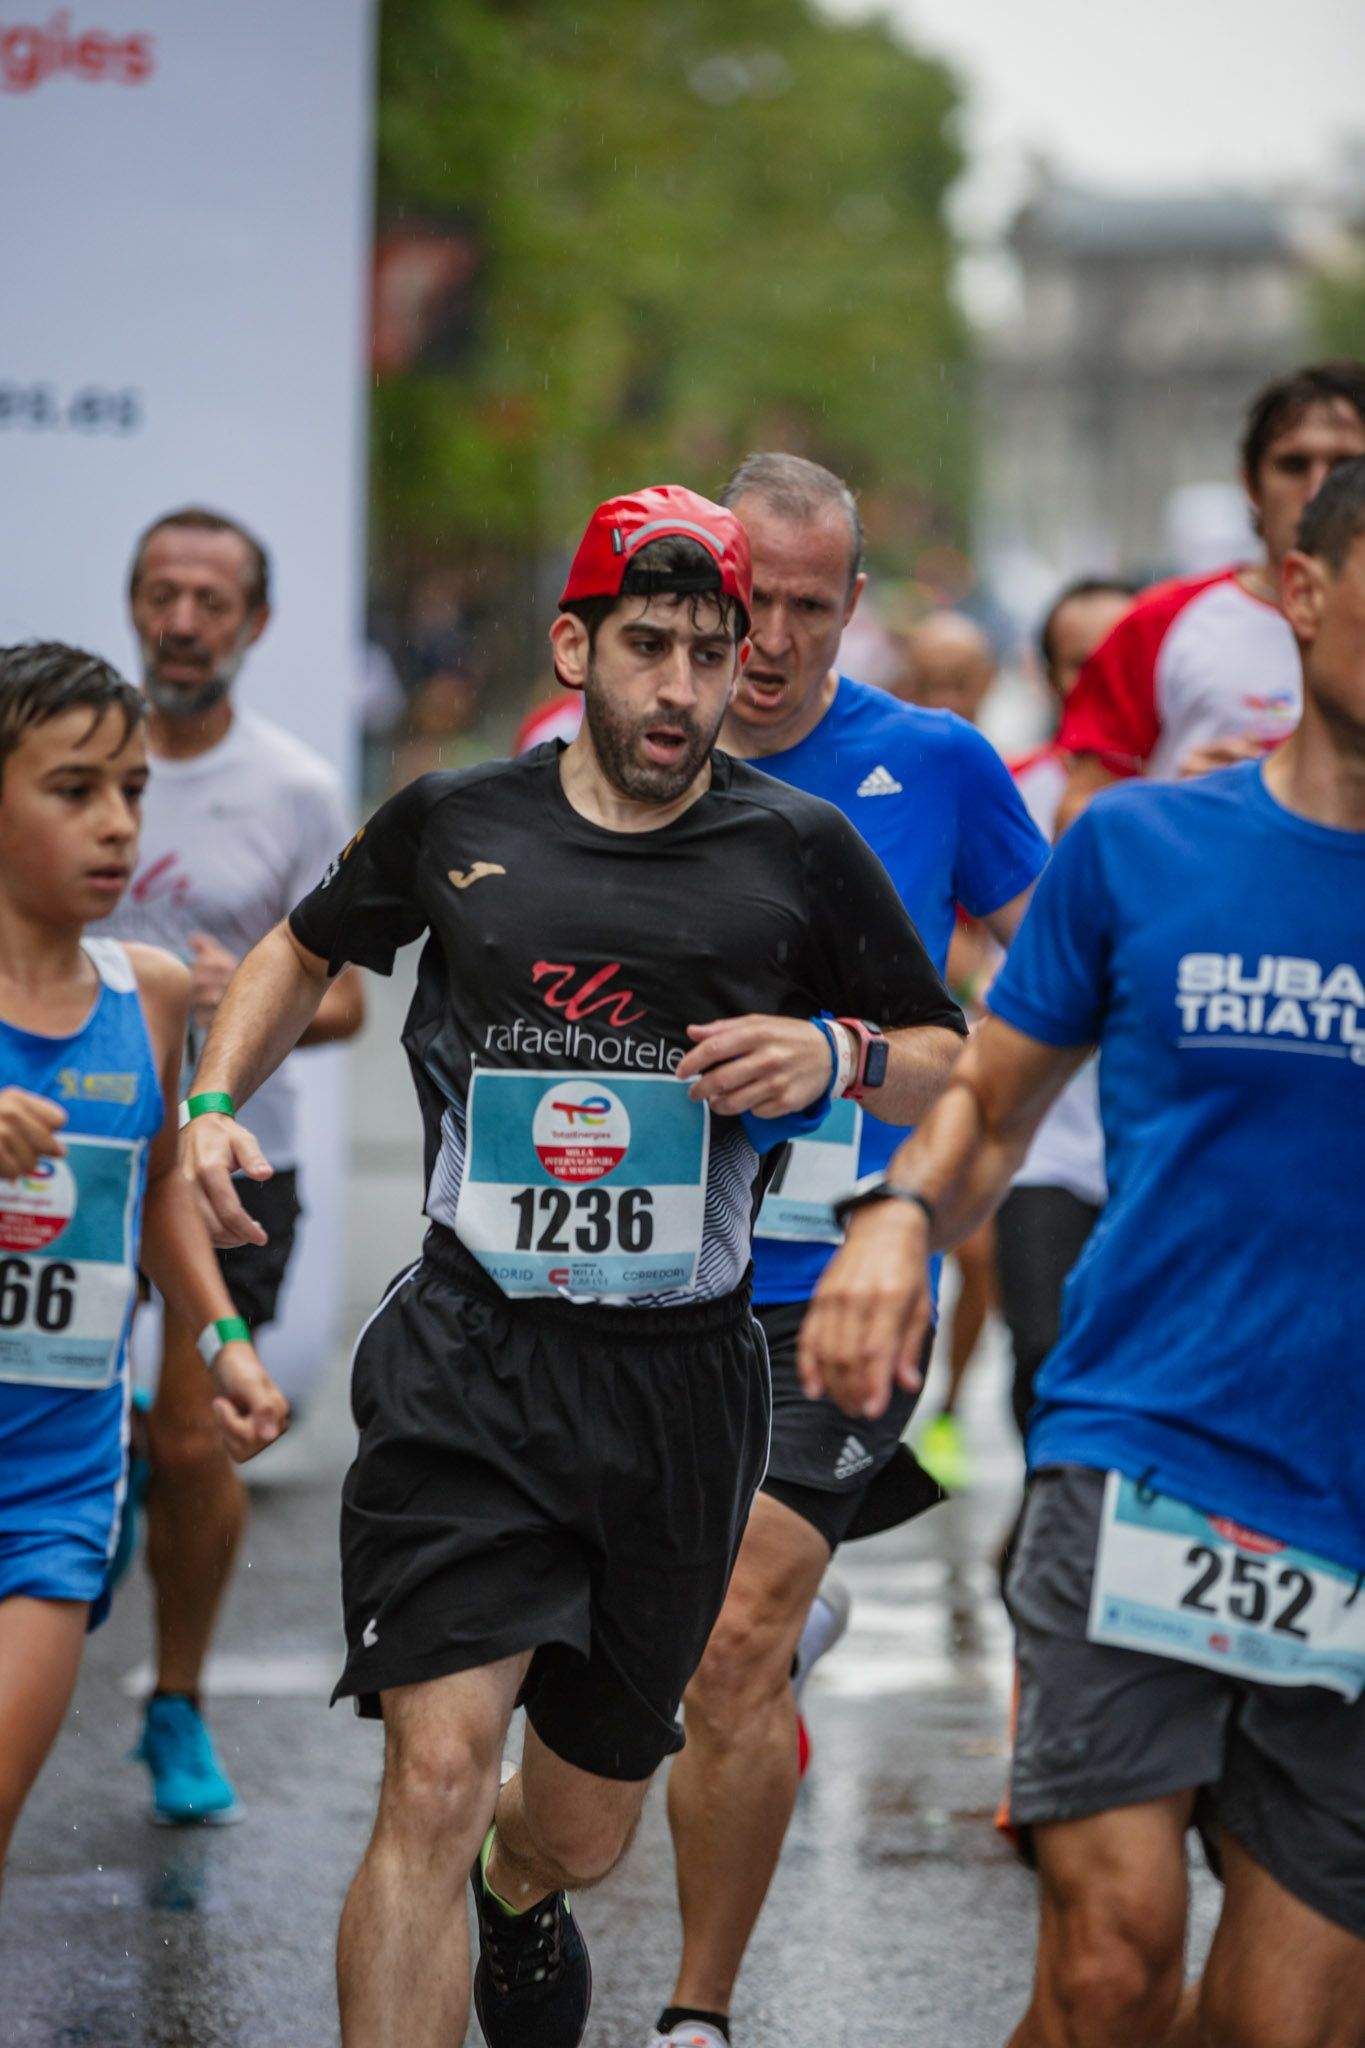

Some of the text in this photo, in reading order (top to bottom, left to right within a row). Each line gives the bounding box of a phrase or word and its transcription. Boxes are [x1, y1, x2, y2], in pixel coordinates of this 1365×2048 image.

[1177, 952, 1365, 1007] SUBA
[511, 1187, 654, 1253] 1236
[1179, 1545, 1314, 1643] 252
